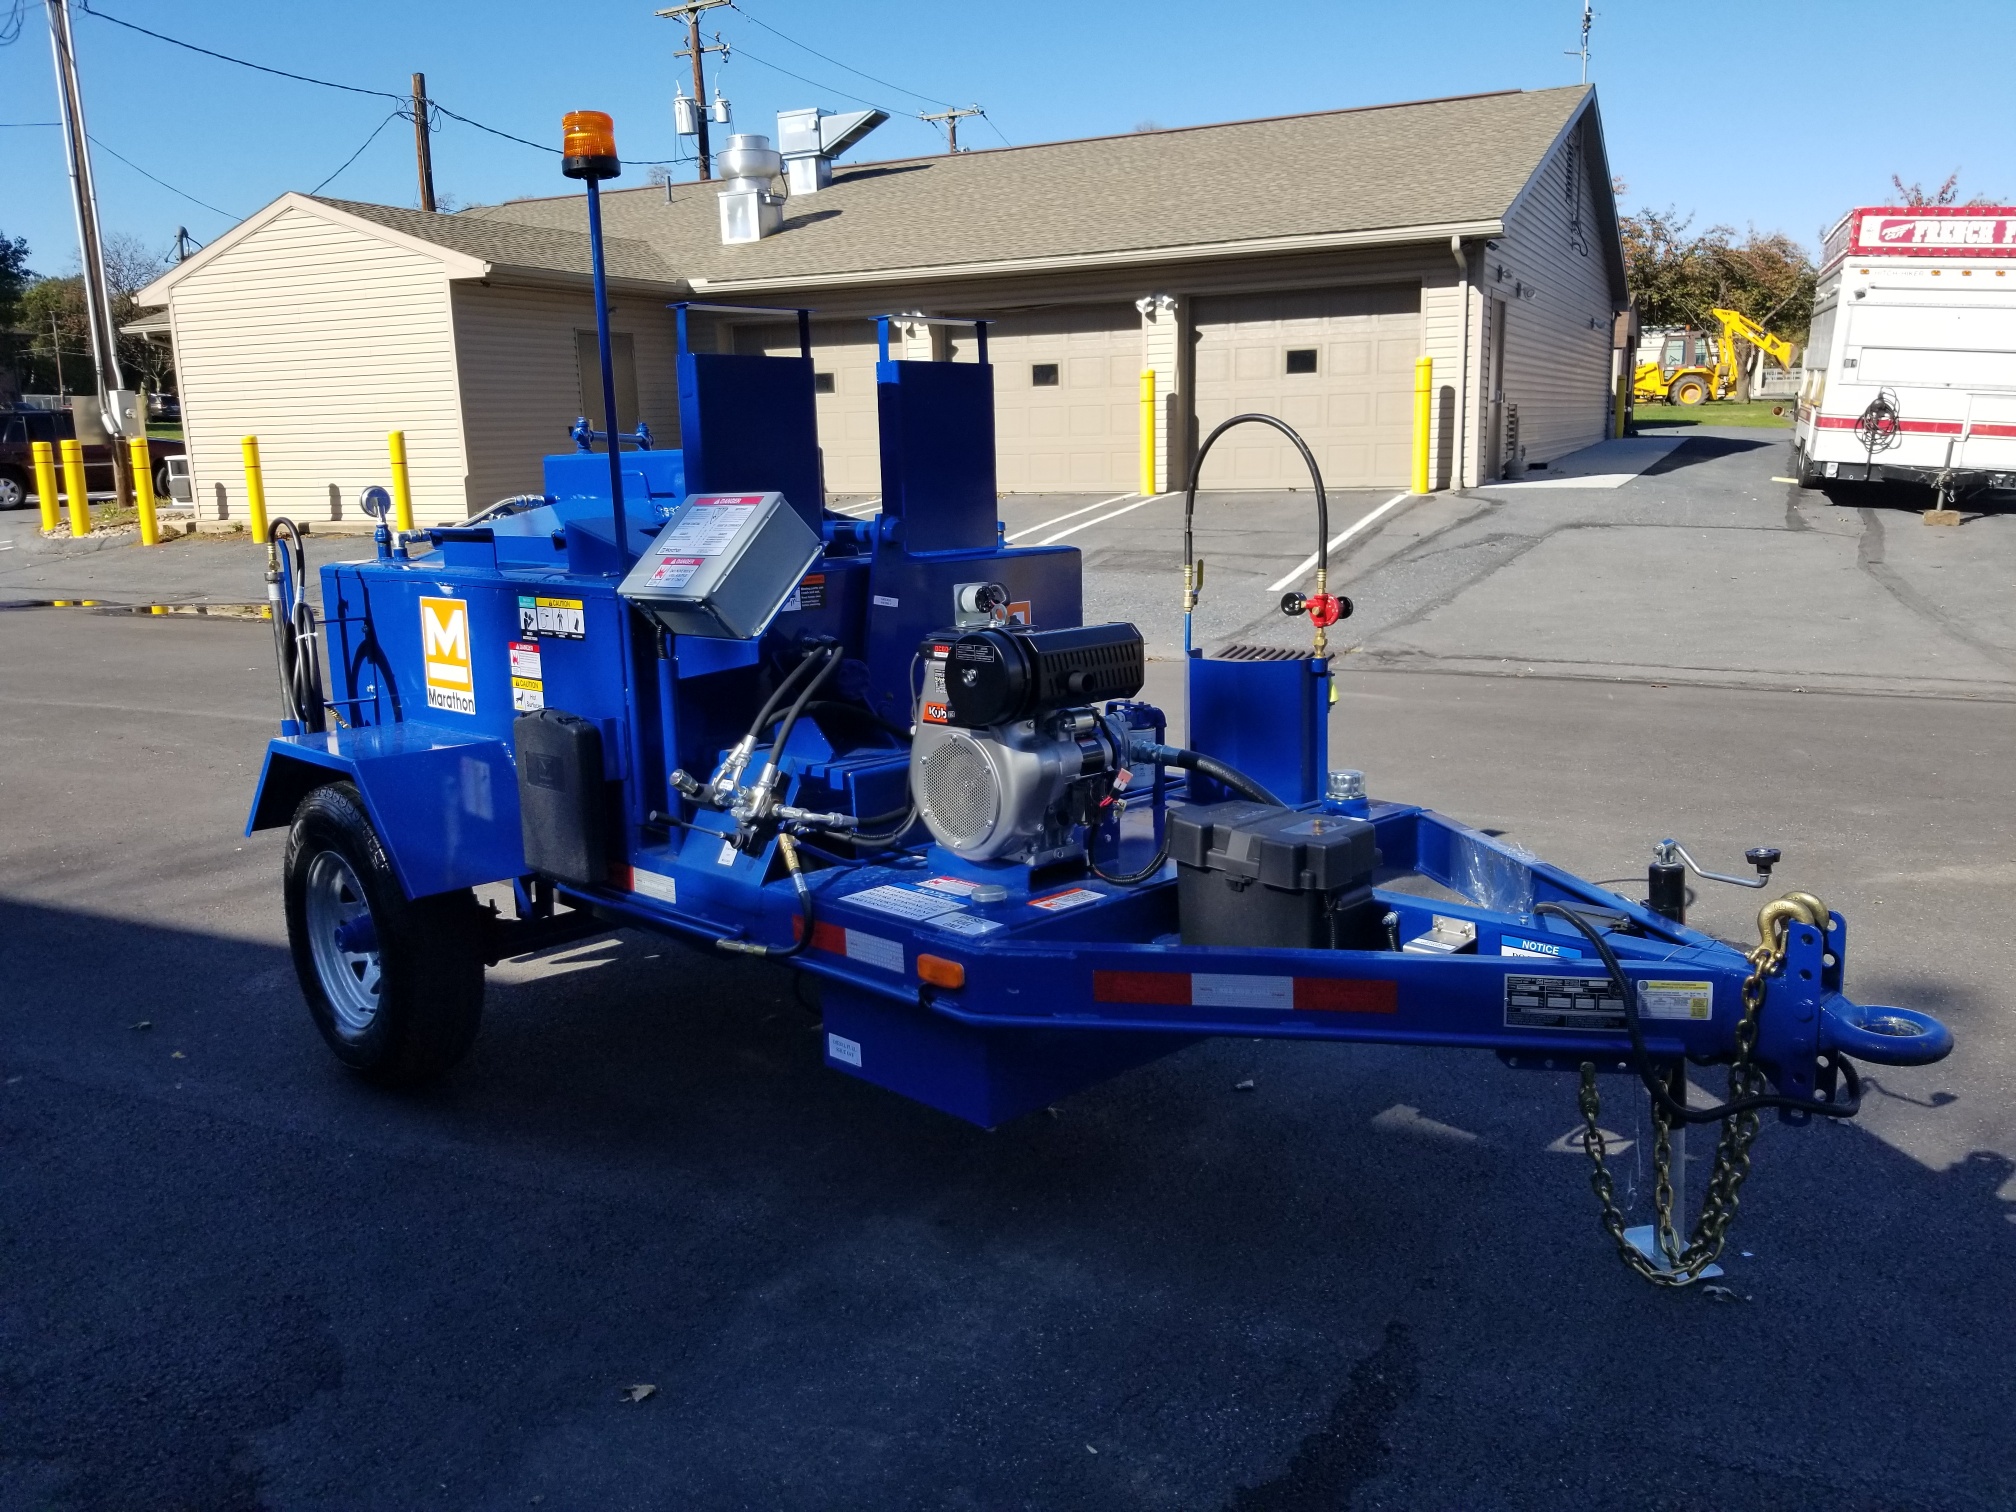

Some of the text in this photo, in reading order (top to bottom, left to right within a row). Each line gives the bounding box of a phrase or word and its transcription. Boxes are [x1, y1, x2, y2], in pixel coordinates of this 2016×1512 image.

[552, 600, 571, 608] CAUTION
[424, 606, 467, 660] M
[519, 680, 538, 689] CAUTION
[428, 688, 475, 713] Marathon
[1522, 940, 1560, 955] NOTICE
